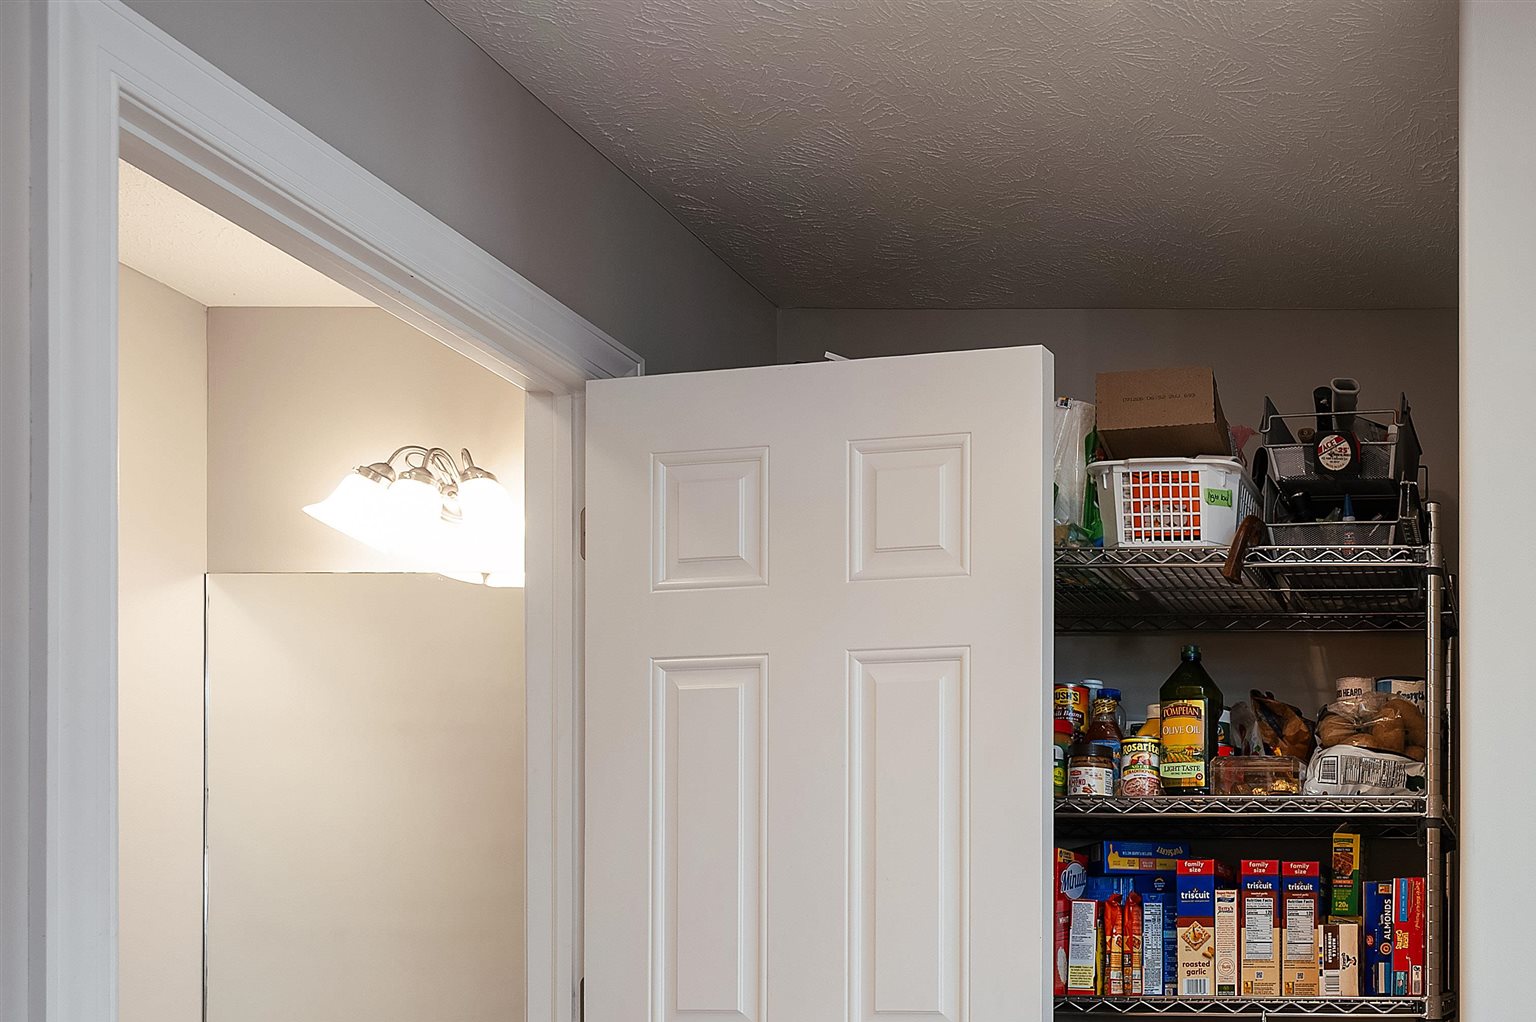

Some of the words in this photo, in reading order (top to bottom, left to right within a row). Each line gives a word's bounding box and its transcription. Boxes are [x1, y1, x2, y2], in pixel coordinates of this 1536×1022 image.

[1055, 691, 1079, 702] USH'S
[1163, 706, 1199, 718] POMPEIAN
[1162, 726, 1185, 735] OLIVE
[1185, 724, 1201, 734] OIL
[1122, 742, 1160, 756] Rosarita
[1163, 765, 1181, 773] LIGHT
[1181, 764, 1201, 772] TASTE
[1248, 861, 1269, 869] family
[1246, 881, 1272, 890] triscuit
[1288, 882, 1313, 891] triscuit
[1181, 889, 1210, 899] triscuit
[1384, 899, 1392, 940] ALMONDS
[1186, 968, 1207, 976] garlic
